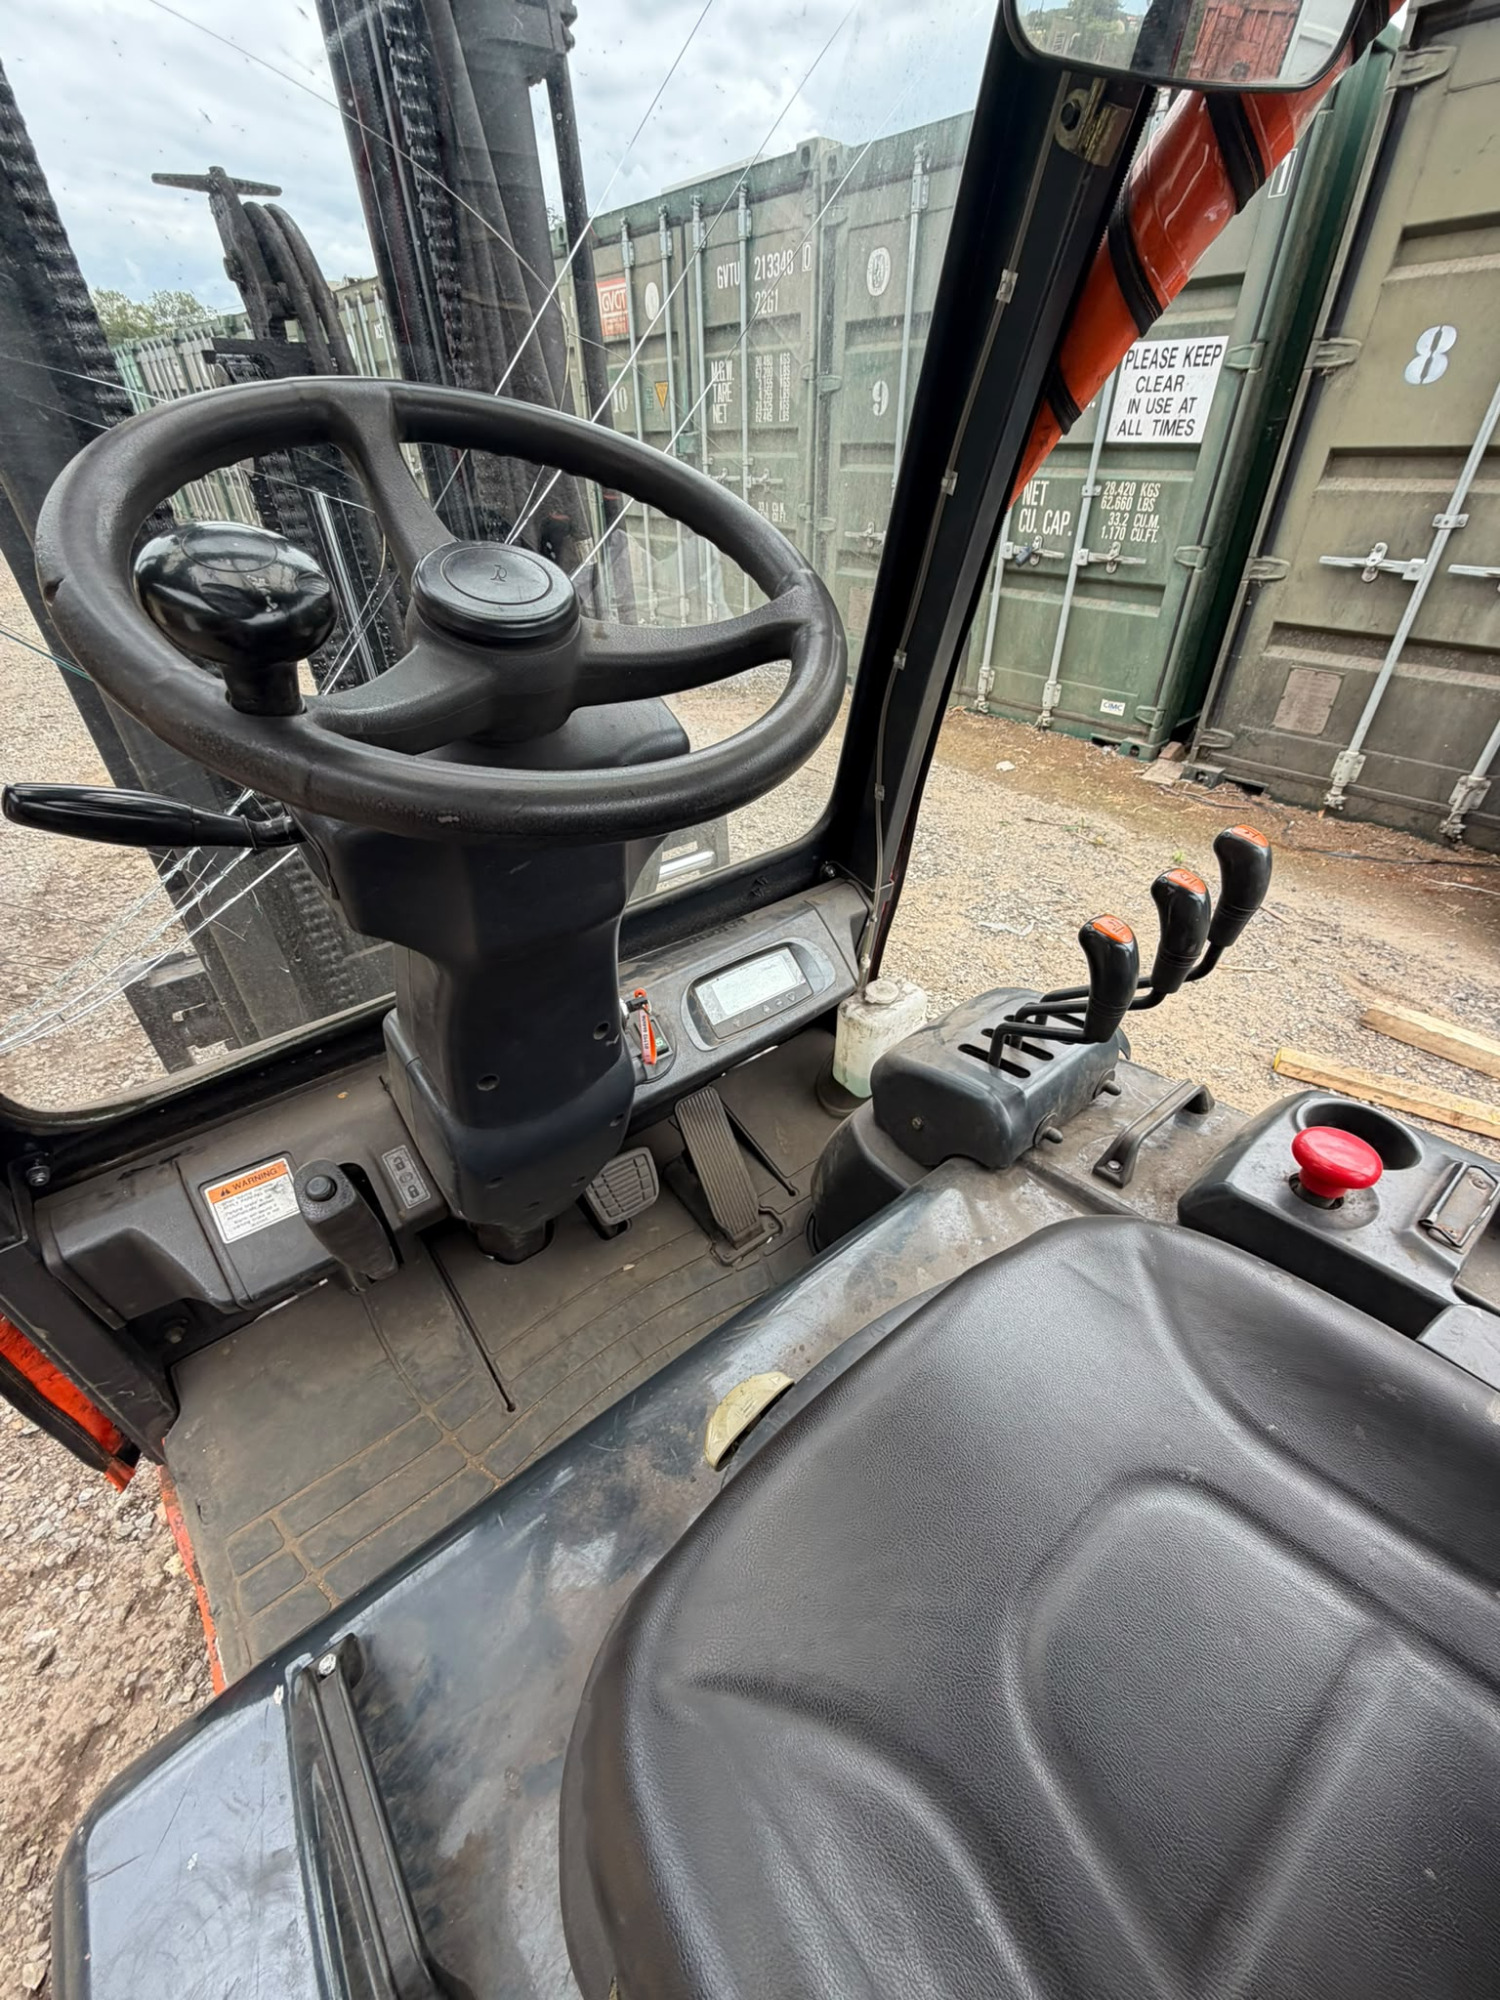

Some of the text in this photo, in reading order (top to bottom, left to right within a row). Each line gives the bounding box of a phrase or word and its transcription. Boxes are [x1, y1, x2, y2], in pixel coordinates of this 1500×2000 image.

[716, 260, 740, 289] GVTU
[754, 249, 794, 281] 213348
[754, 289, 778, 315] 22G1
[1124, 344, 1223, 370] PLEASE KEEP
[1404, 325, 1457, 384] 8
[712, 381, 733, 403] TARE
[1136, 374, 1185, 393] CLEAR
[612, 386, 628, 413] 10
[872, 379, 889, 417] 9
[1127, 397, 1198, 414] IN USE AT
[713, 403, 728, 424] NET
[1117, 418, 1196, 437] ALL TIMES
[1021, 480, 1049, 506] NET
[1140, 482, 1161, 498] KGS
[1137, 497, 1156, 512] LBS
[1018, 508, 1037, 533] CU.
[1042, 510, 1072, 537] CAP.
[1107, 511, 1129, 527] 33.2
[1103, 702, 1123, 712] CIMC
[232, 1168, 278, 1190] WARNING
